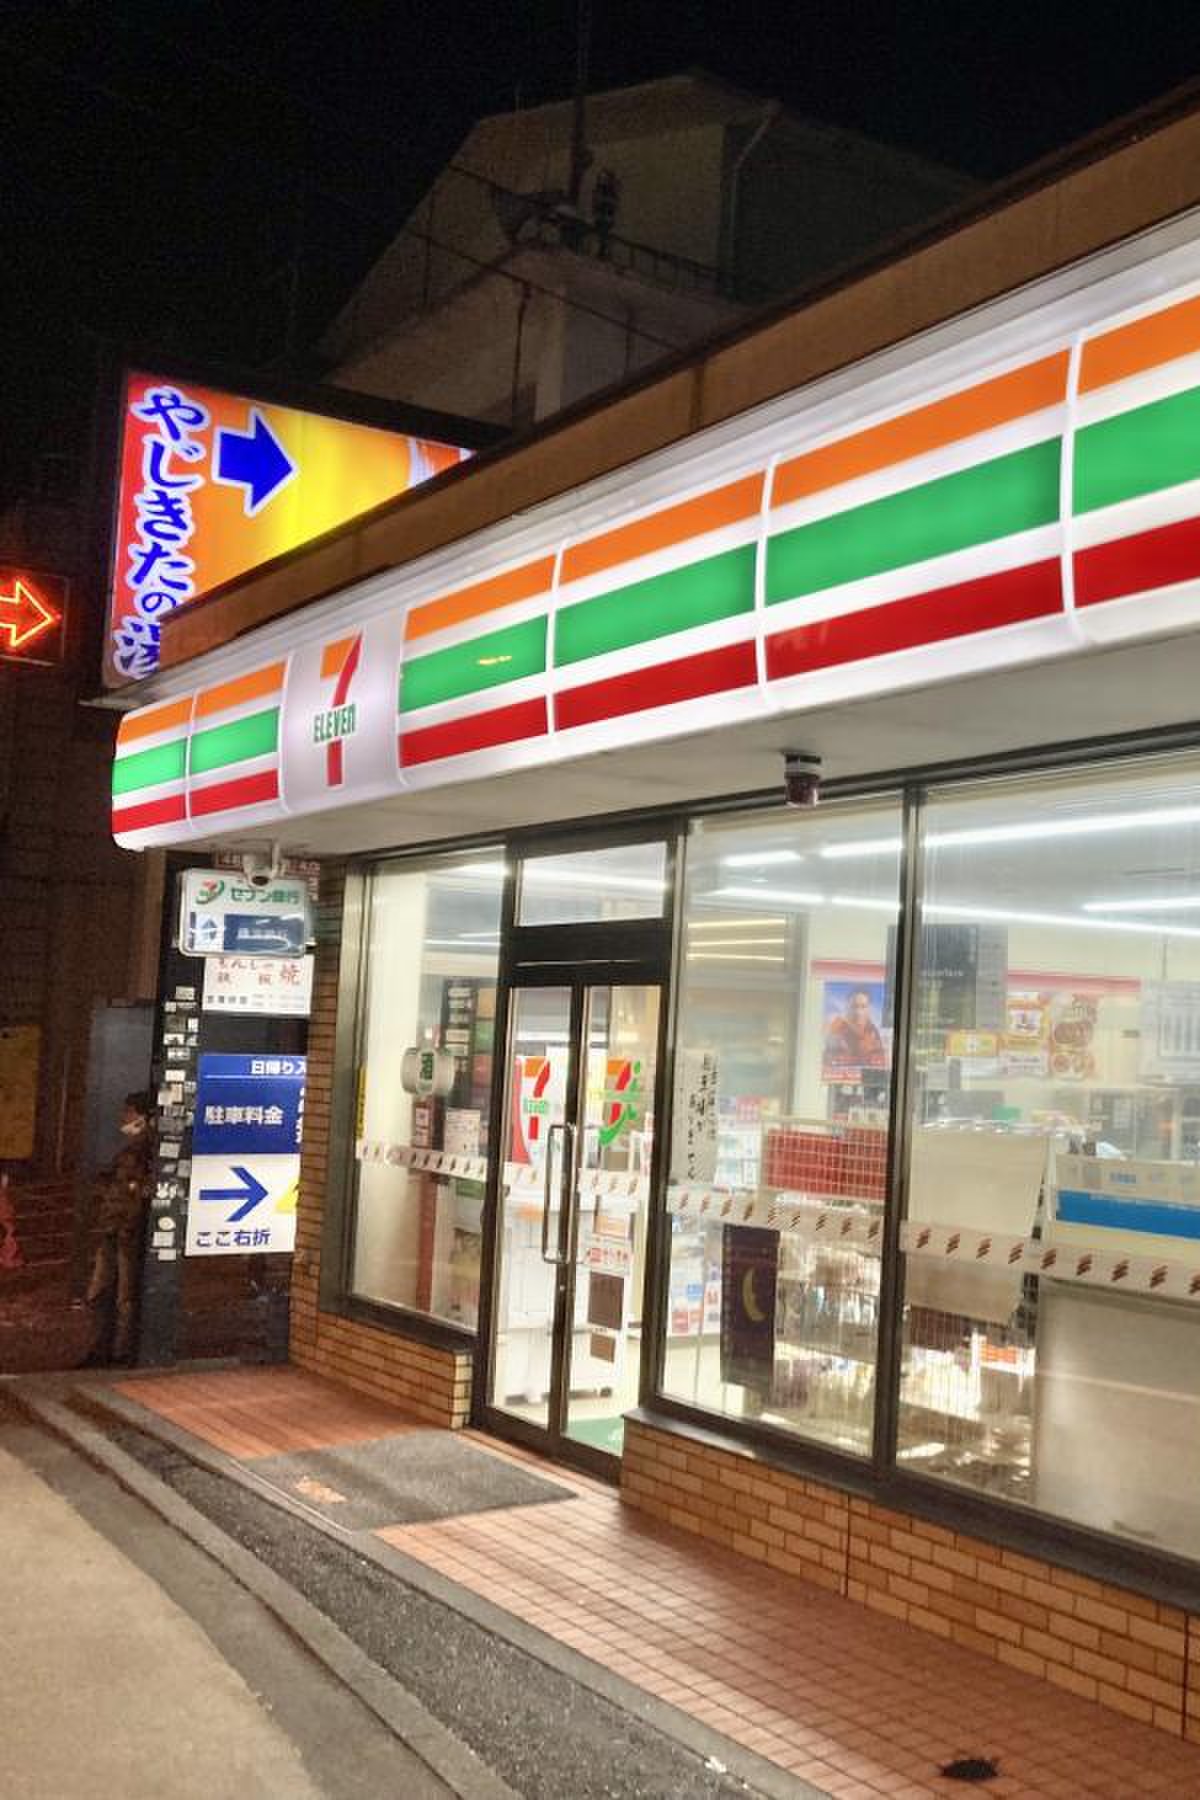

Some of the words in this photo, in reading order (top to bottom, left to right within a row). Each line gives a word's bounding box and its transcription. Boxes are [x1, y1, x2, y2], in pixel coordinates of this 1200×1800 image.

[204, 1105, 284, 1125] 駐車料金
[196, 1228, 271, 1248] ここ右折
